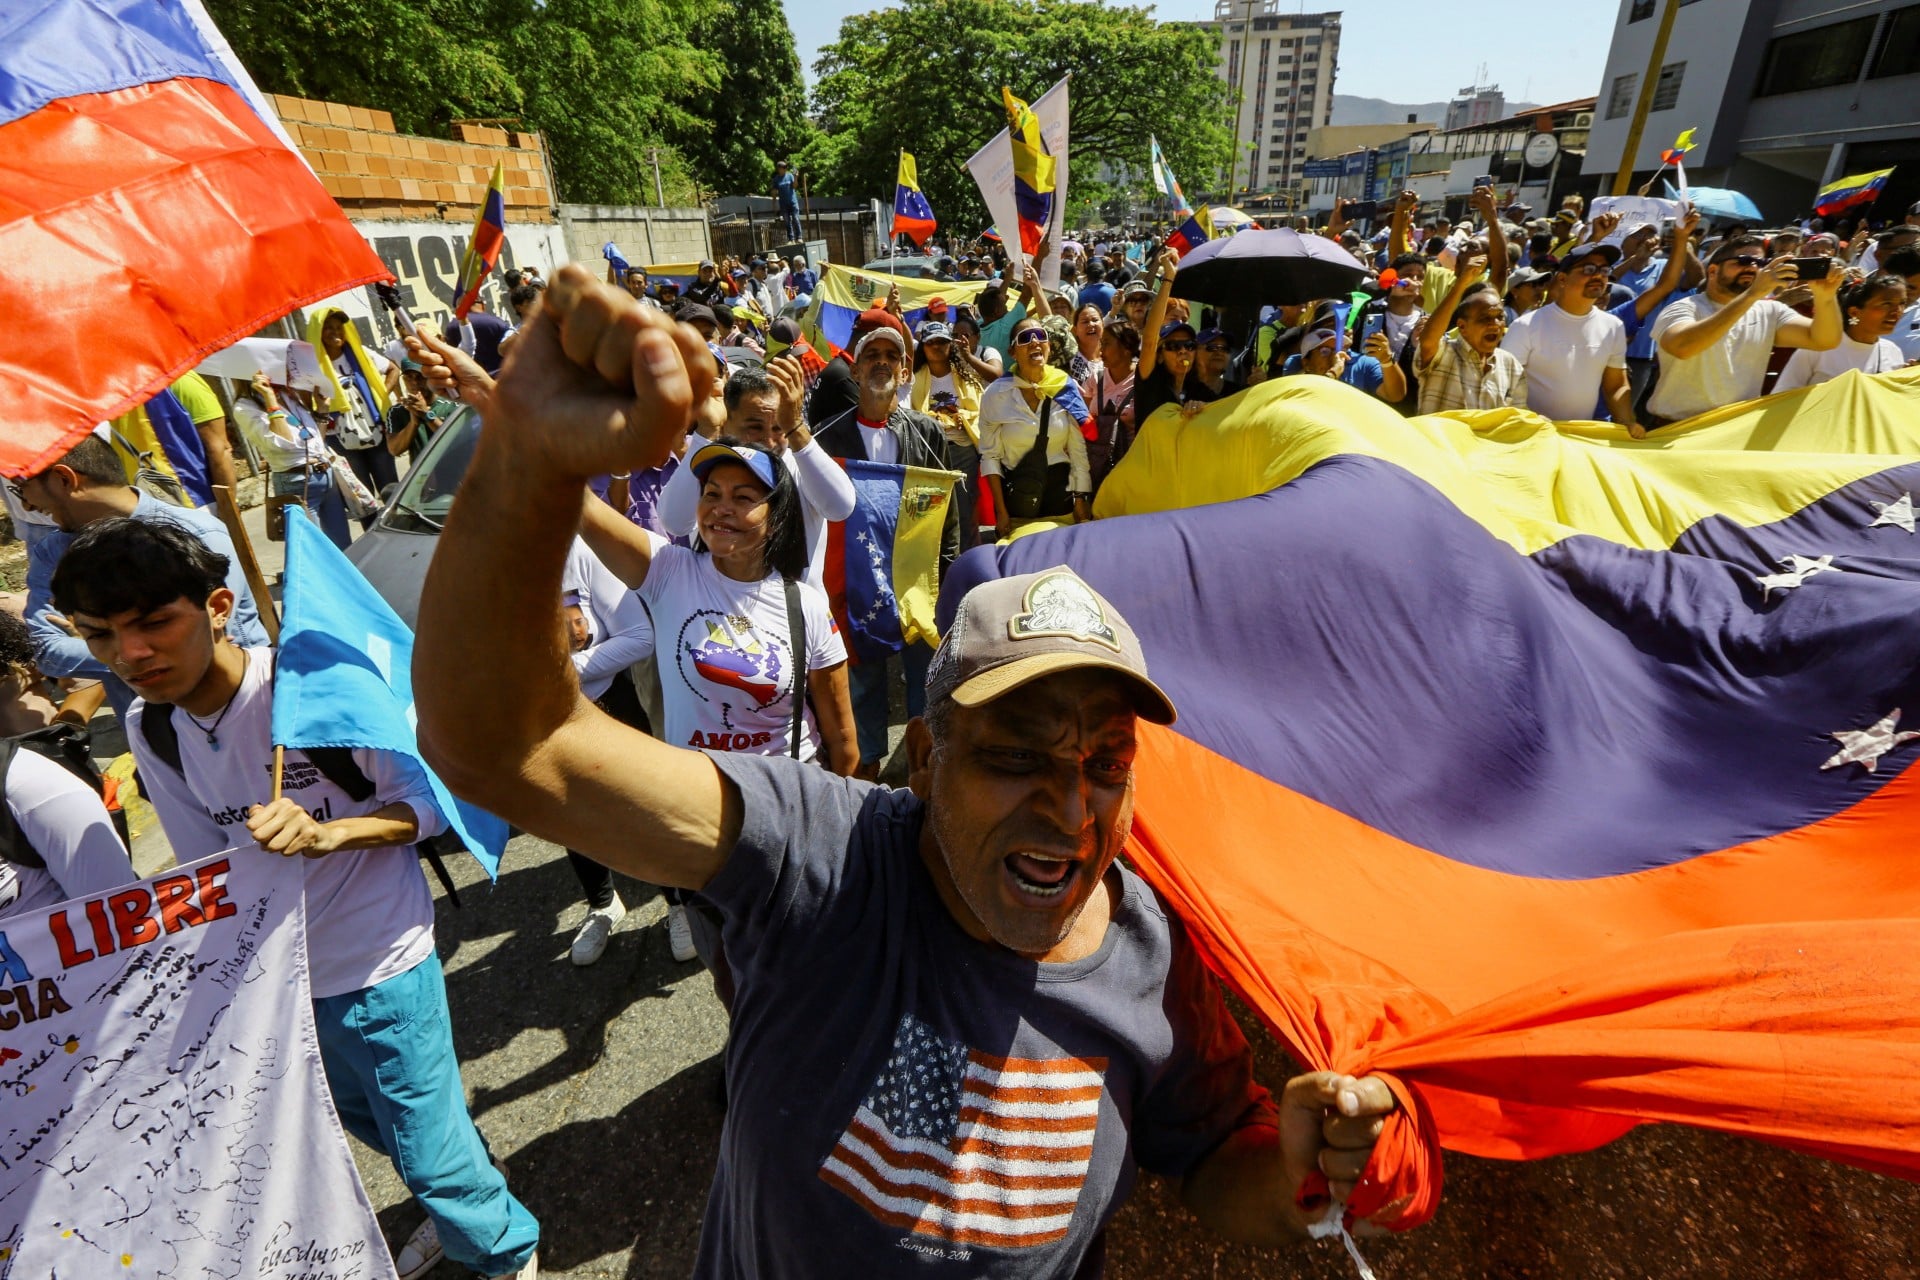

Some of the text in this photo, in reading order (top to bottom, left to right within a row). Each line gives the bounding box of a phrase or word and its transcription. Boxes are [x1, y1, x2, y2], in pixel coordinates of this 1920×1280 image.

[688, 730, 771, 751] AMOR
[48, 858, 238, 970] LIBRE
[896, 1238, 946, 1257] Summer
